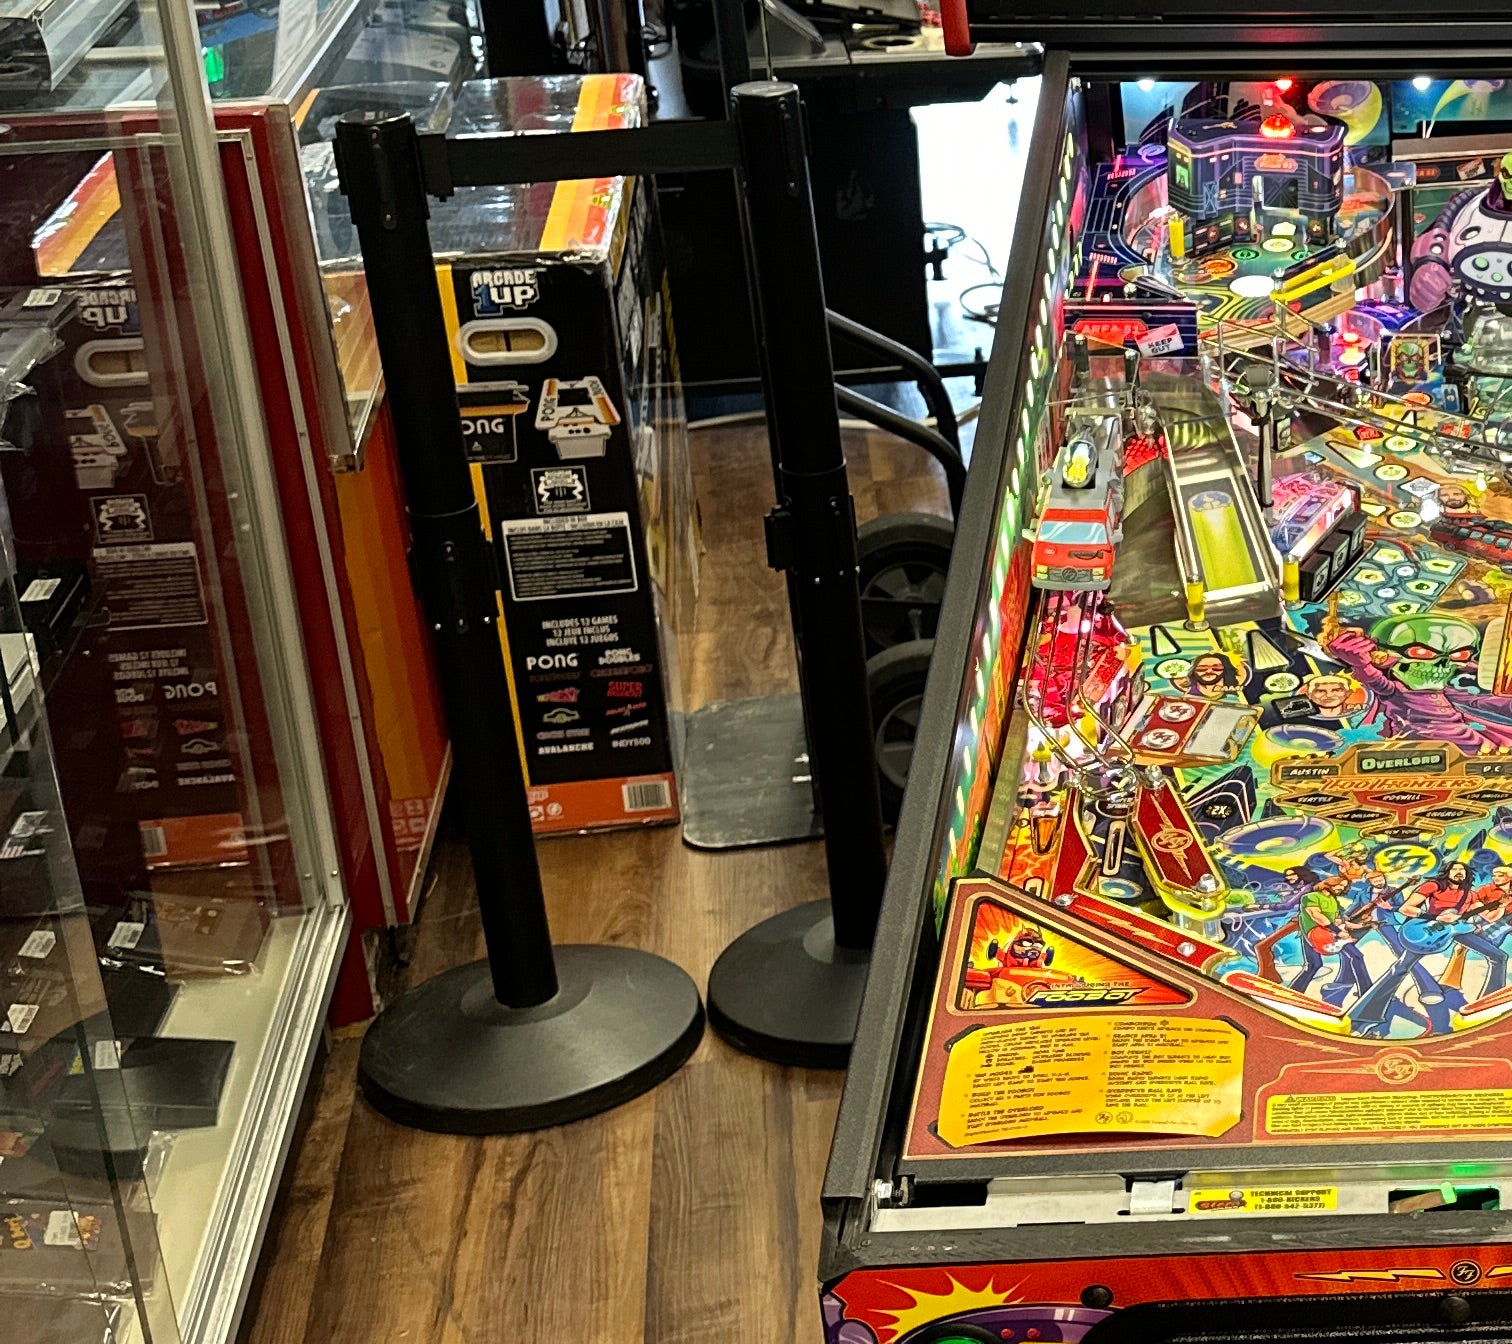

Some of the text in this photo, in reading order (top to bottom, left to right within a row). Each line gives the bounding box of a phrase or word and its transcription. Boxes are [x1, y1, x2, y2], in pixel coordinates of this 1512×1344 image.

[472, 270, 537, 286] ARCADE
[475, 284, 535, 314] 1UP
[1148, 334, 1173, 352] KEEP
[526, 653, 579, 671] PONG
[538, 742, 594, 755] AVALANCHE
[1361, 754, 1441, 771] OVERLORD
[1289, 767, 1331, 777] AUSTIN
[1212, 805, 1228, 815] 2X
[1031, 988, 1144, 1002] FOOBOT
